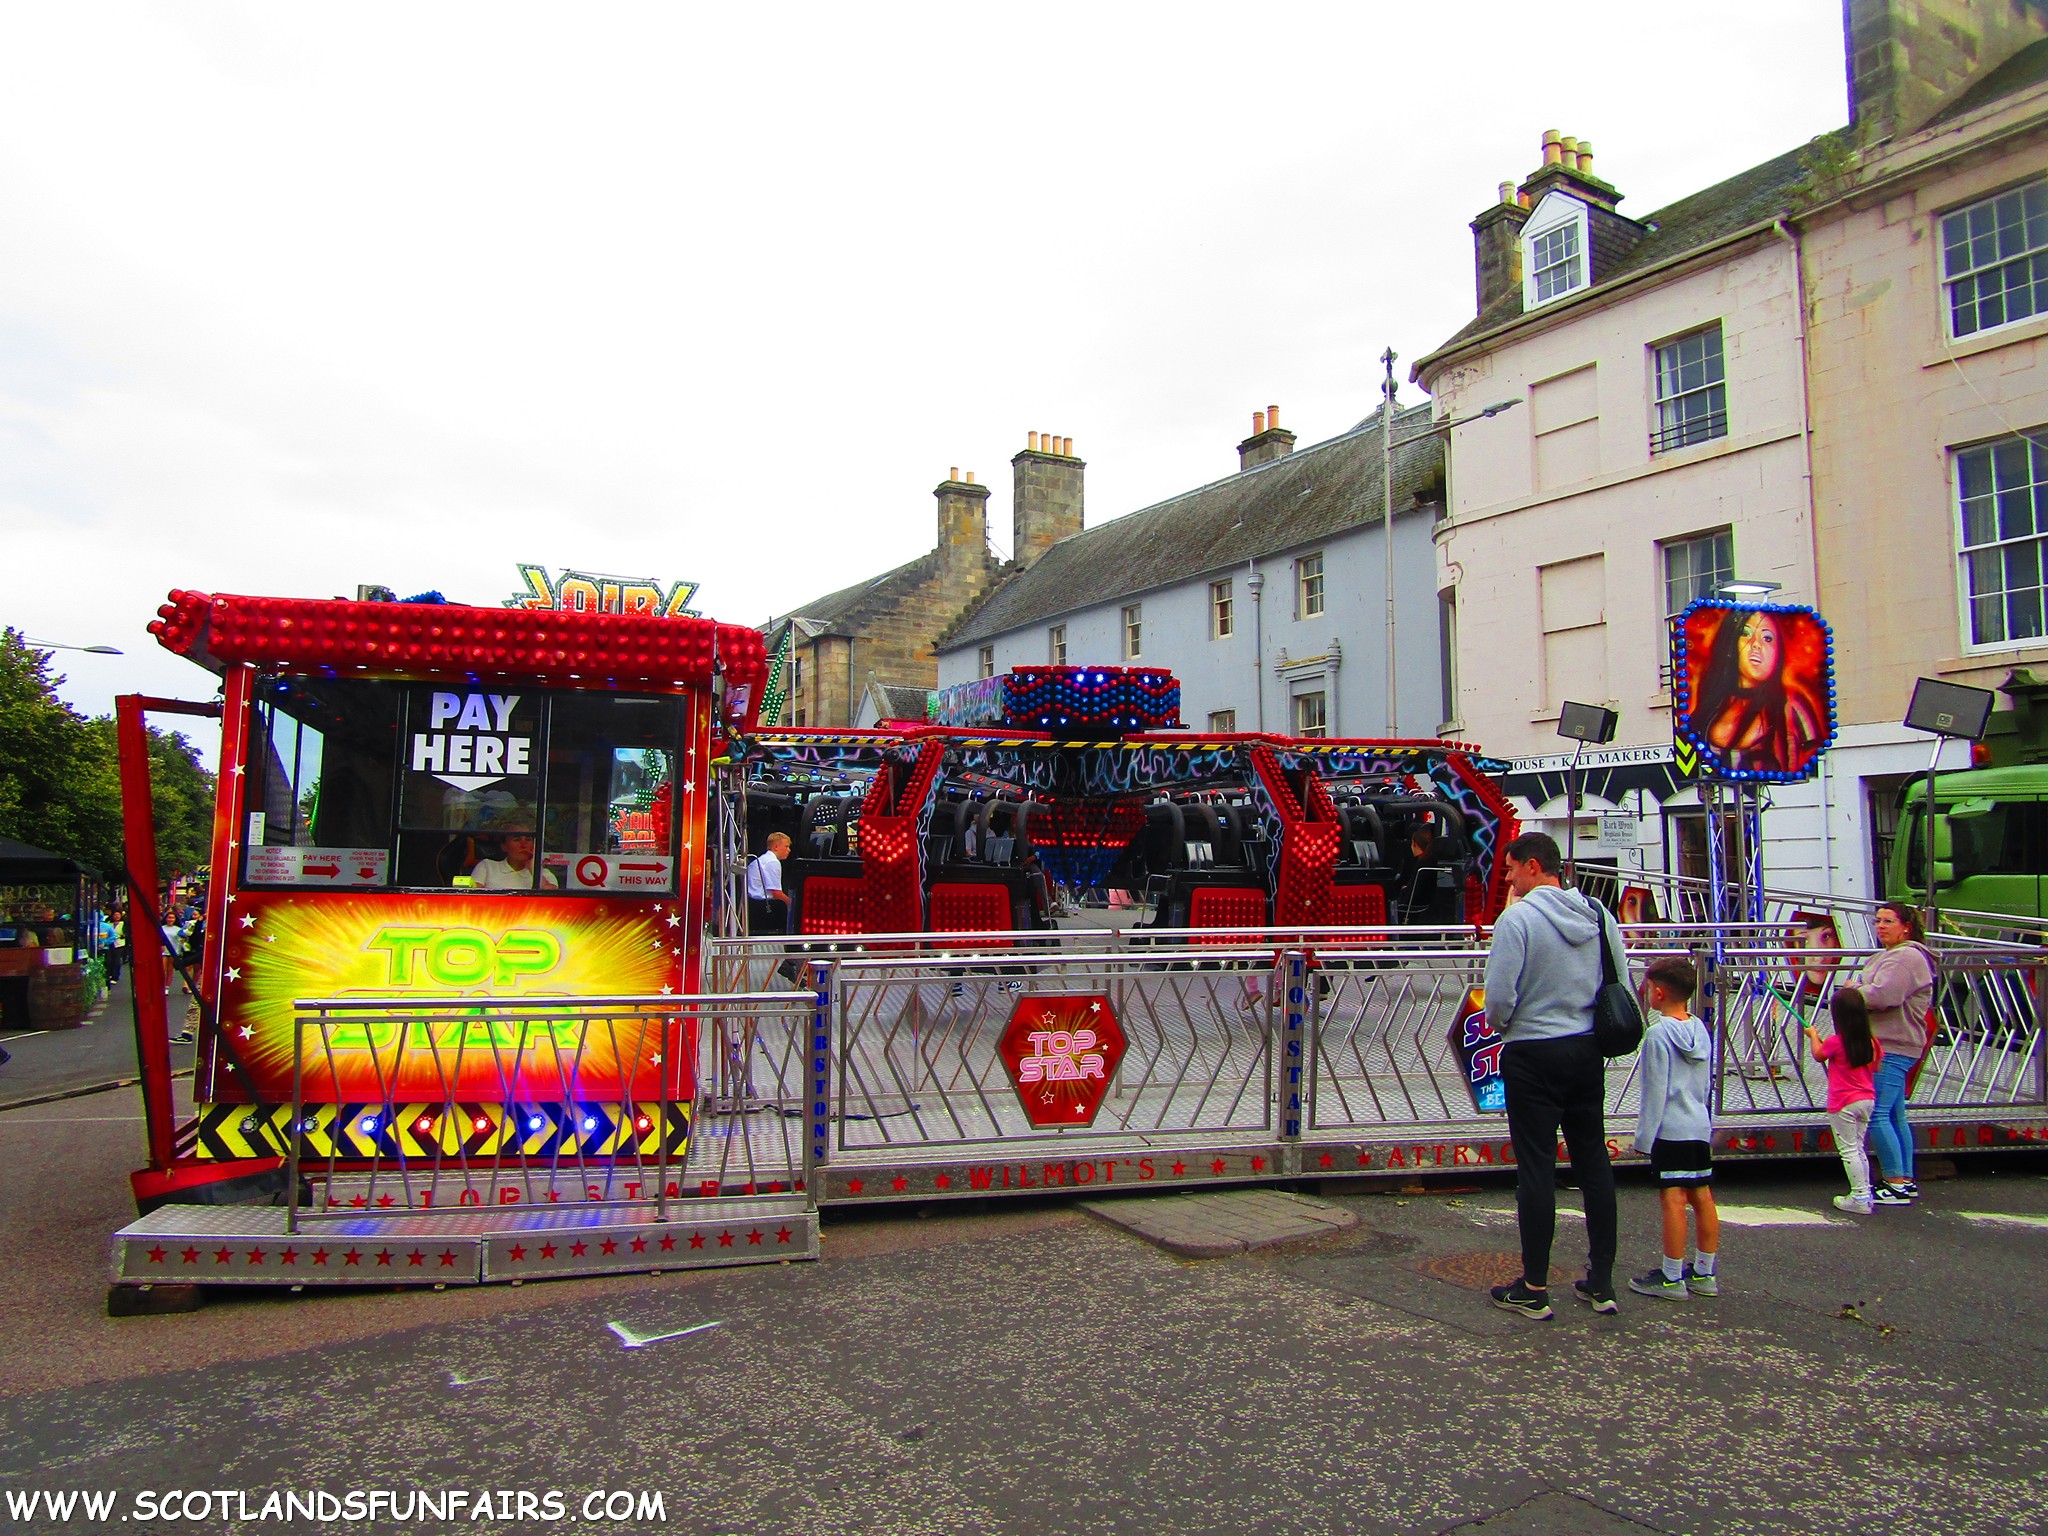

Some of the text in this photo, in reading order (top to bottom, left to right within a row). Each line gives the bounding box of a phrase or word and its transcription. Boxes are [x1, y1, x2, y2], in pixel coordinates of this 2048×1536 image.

[431, 692, 521, 731] PAY
[413, 733, 530, 774] HERE
[1512, 758, 1545, 771] OUSE
[1561, 754, 1592, 767] KLT
[1598, 748, 1660, 764] MAKERS
[575, 855, 608, 887] Q
[618, 875, 668, 885] THIS WAY
[367, 927, 561, 986] TOP
[322, 989, 587, 1050] STAR
[1463, 1010, 1502, 1047] SU
[1028, 1029, 1097, 1056] TOP
[814, 969, 829, 1159] THURSTONS
[1019, 1054, 1105, 1082] STAR
[1470, 1042, 1505, 1082] ST
[1480, 1082, 1497, 1095] THE
[1485, 1092, 1505, 1106] BE
[1791, 1126, 1994, 1151] TO TAR
[969, 1158, 1155, 1190] WILMOT'S
